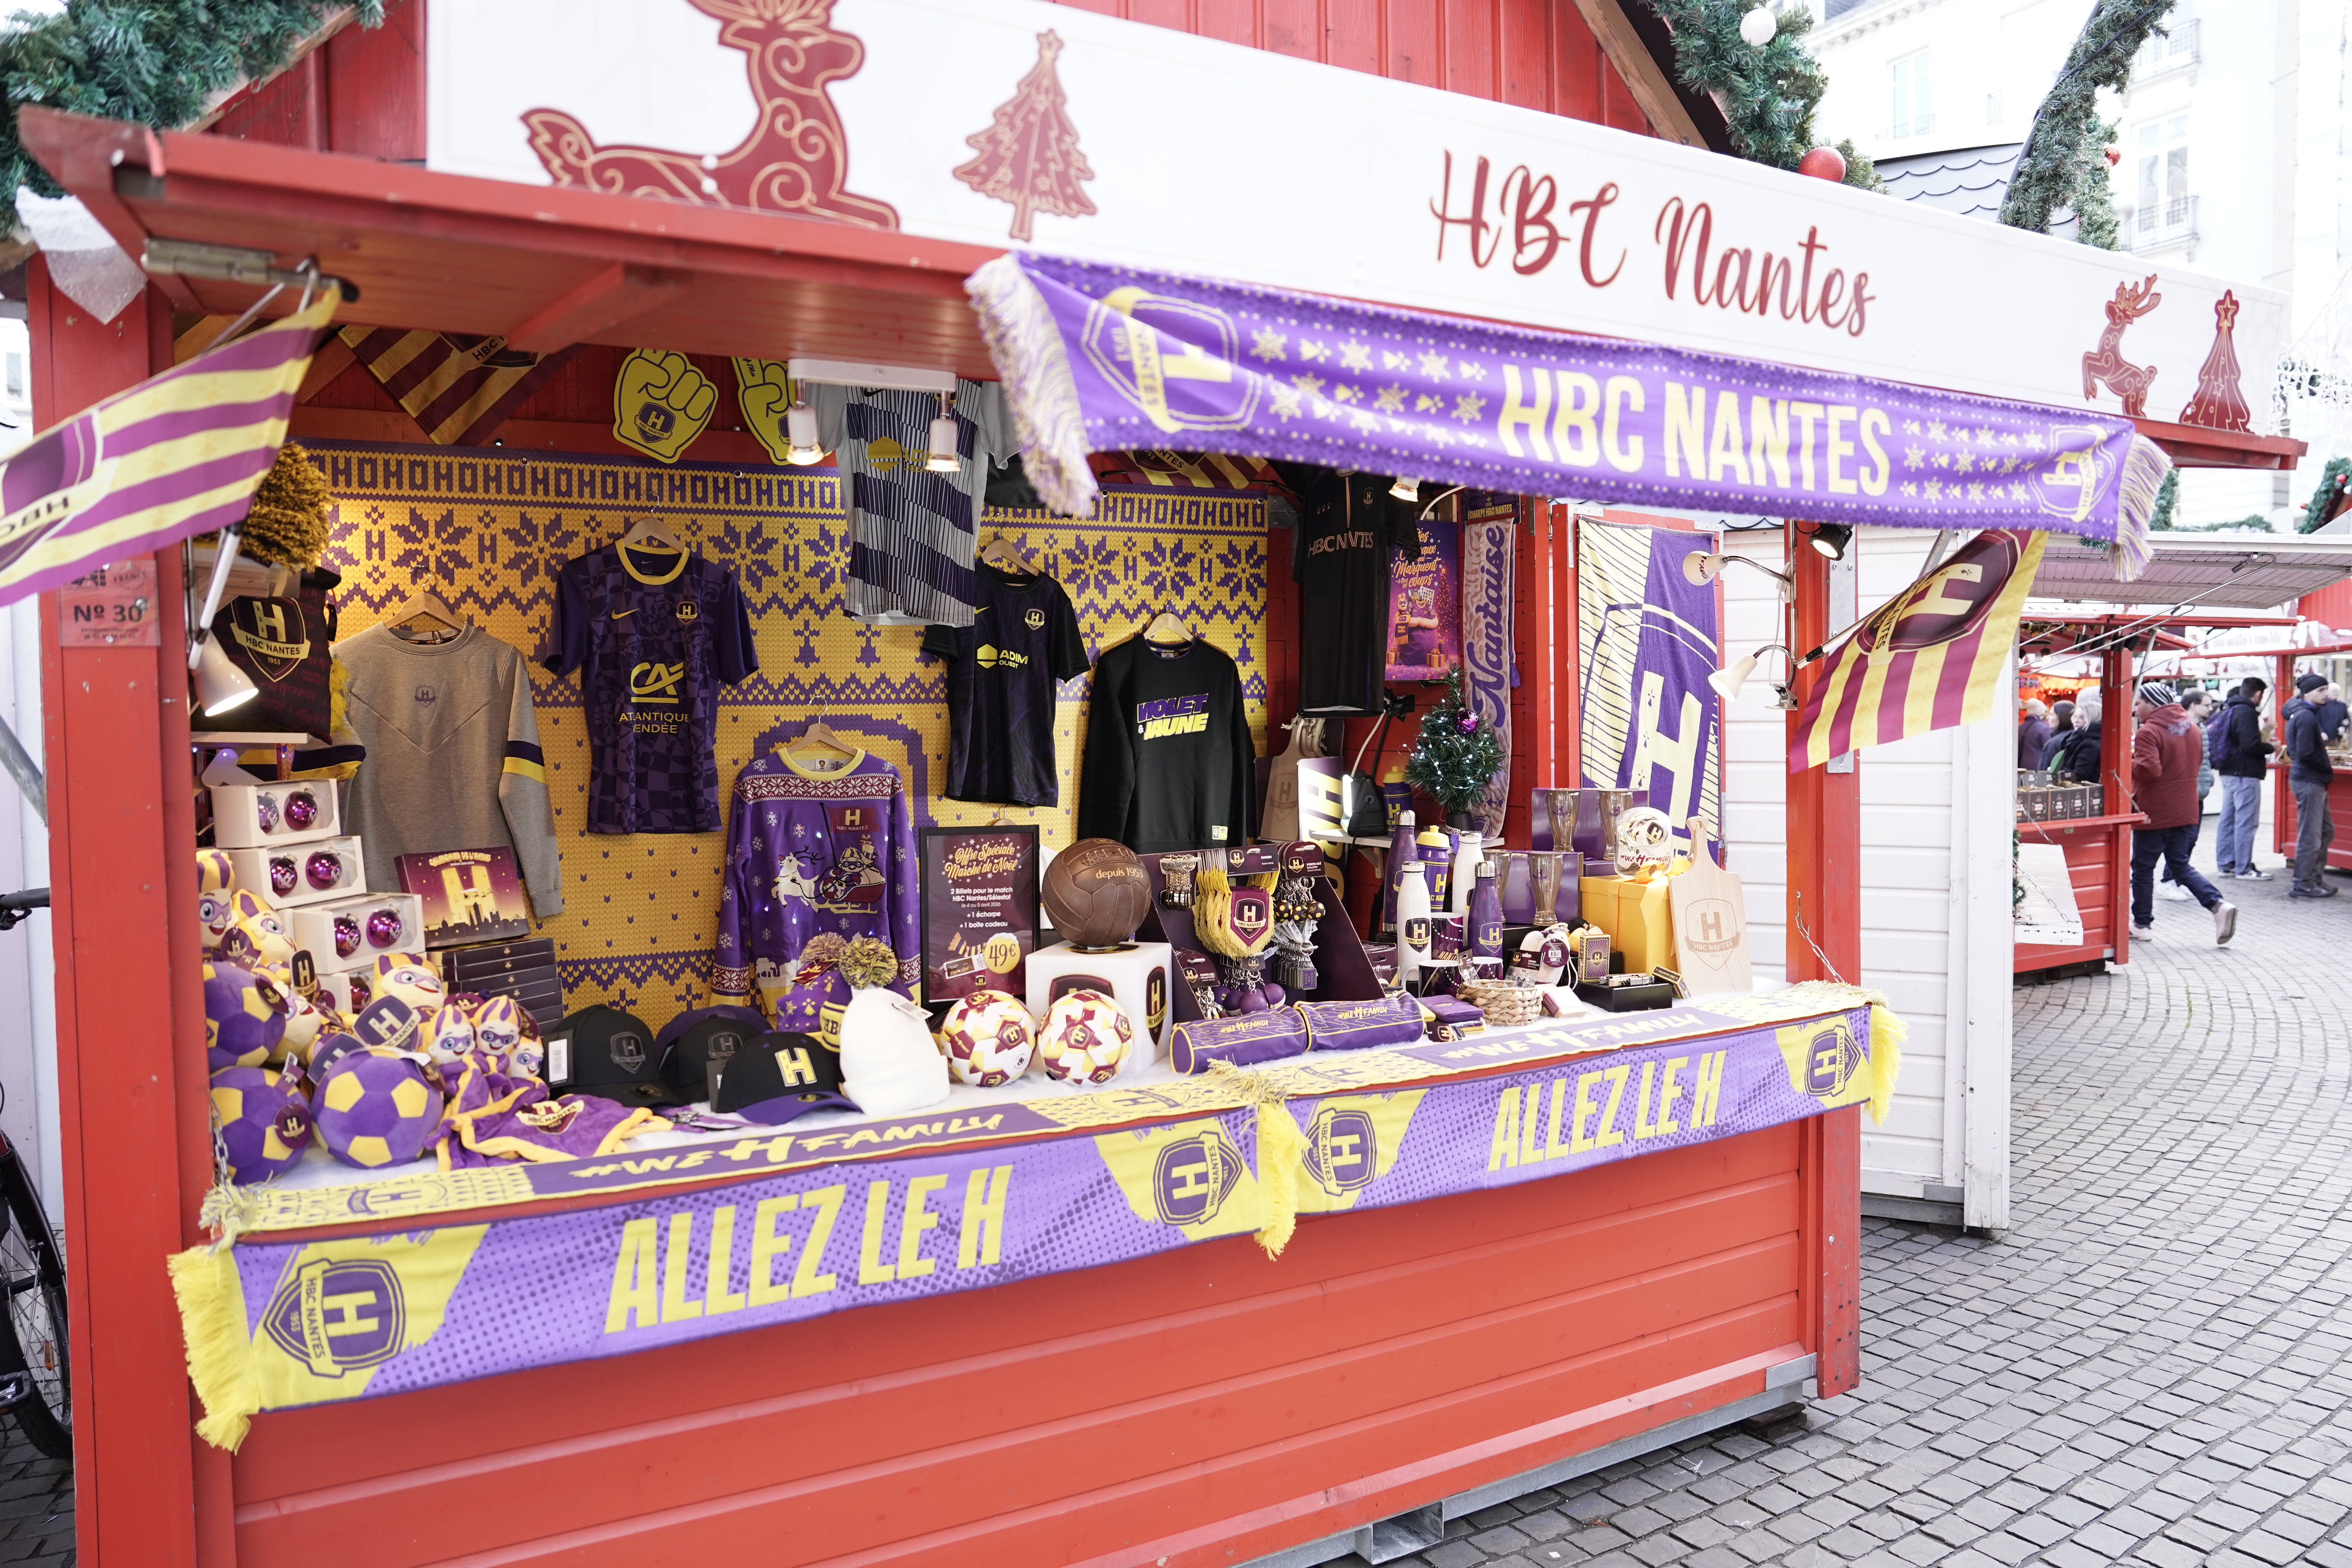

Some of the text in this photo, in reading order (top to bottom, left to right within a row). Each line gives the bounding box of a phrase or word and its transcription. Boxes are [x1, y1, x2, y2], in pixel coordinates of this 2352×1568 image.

[1431, 149, 1877, 337] HBC Nantes
[472, 339, 498, 361] HBC
[648, 428, 665, 437] NANTES
[1497, 363, 1893, 497] HBC NANTES
[1468, 503, 1512, 520] ÉCHARPE HBC NANTES
[1308, 536, 1335, 558] HBC
[1394, 556, 1442, 579] Marquent
[1408, 573, 1434, 587] coups
[113, 605, 142, 622] 30
[1876, 597, 1909, 650] NANTES
[1466, 524, 1505, 728] Nantaise
[246, 635, 300, 655] HBC NANTES
[267, 657, 281, 665] 1953
[999, 650, 1029, 664] ADIM
[999, 660, 1019, 668] OUEST
[1137, 693, 1209, 724] VIOLET
[632, 722, 678, 733] VENDÉE
[1138, 712, 1209, 740] & JAUNE
[429, 851, 492, 867] CALENDRIER DE L'AVENT
[955, 842, 1015, 866] Offre Spéciale
[944, 857, 1018, 880] Marché de Noël
[1096, 867, 1143, 879] depuis 1953
[989, 943, 1016, 967] 49€
[1708, 940, 1733, 951] NANTES
[1154, 1009, 1164, 1024] NANTES
[394, 1019, 416, 1042] NANTES
[545, 1105, 577, 1122] NANTES
[1488, 1050, 1727, 1172] ALLEZ LE H
[1321, 1122, 1334, 1182] HBC NANTES
[1207, 1145, 1219, 1207] HBC NANTES
[604, 1165, 1013, 1334] ALLEZ LE H
[289, 1311, 299, 1333] 1953
[305, 1278, 325, 1359] HBC NANTES
